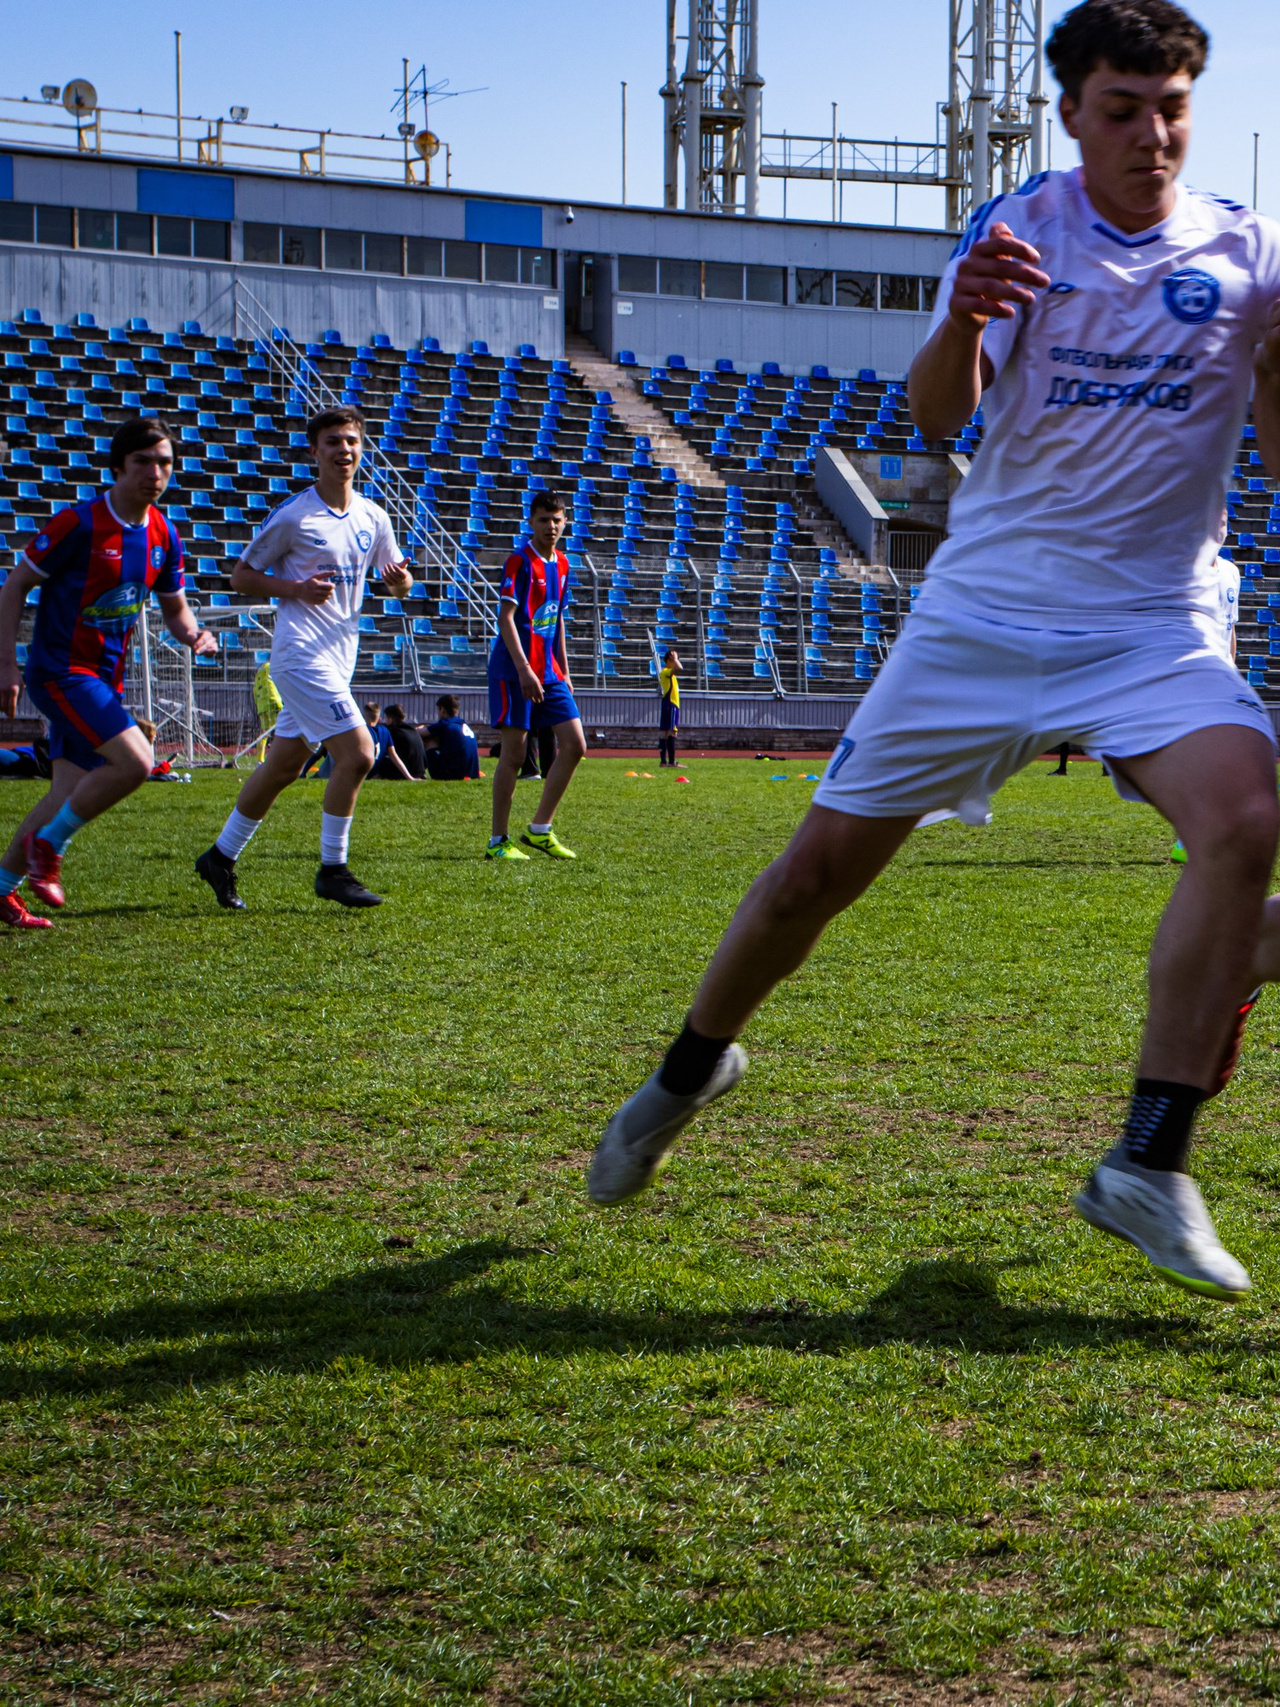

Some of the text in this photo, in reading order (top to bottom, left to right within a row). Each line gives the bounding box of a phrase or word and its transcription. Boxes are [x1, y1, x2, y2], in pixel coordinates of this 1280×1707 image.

[1044, 376, 1192, 411] ДОБРЯКОВ
[884, 461, 898, 473] 11
[329, 700, 355, 721] 10
[827, 737, 857, 779] 7
